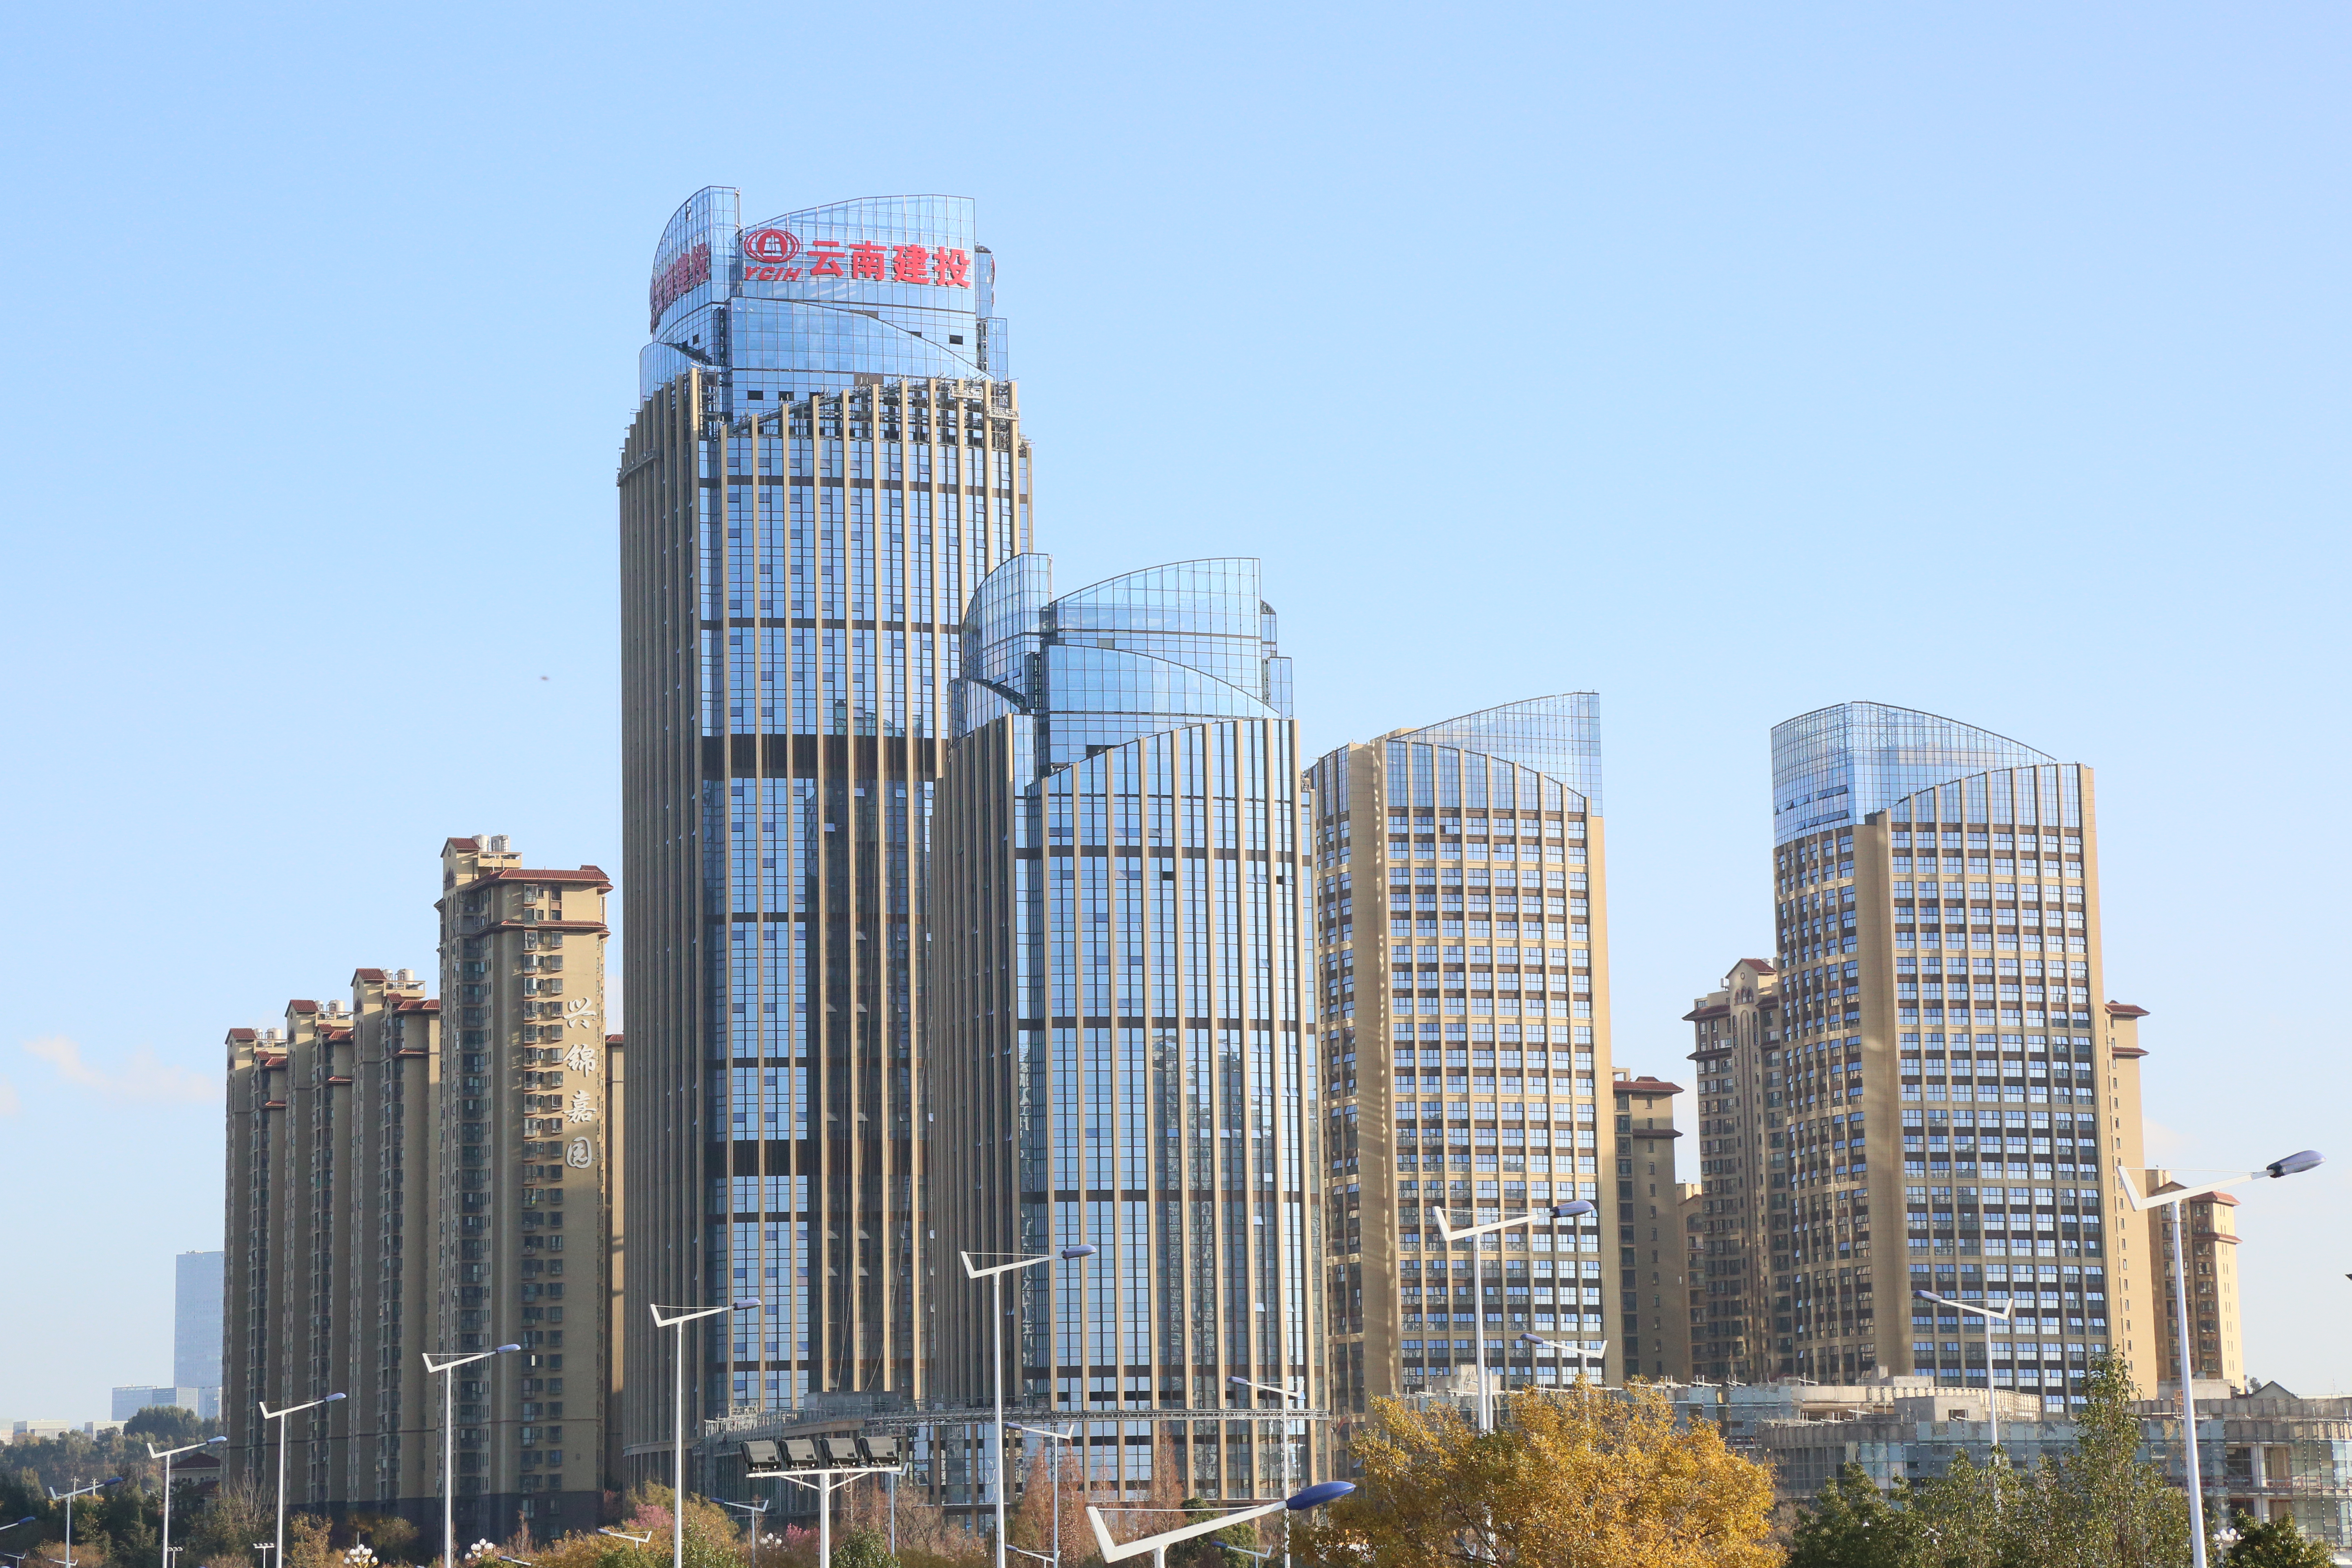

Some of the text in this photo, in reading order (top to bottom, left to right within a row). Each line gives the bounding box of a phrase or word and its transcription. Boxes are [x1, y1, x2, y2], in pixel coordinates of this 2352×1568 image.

[744, 266, 802, 281] YCIH
[807, 240, 971, 288] 云南建投
[564, 997, 596, 1168] 兴锦嘉园
